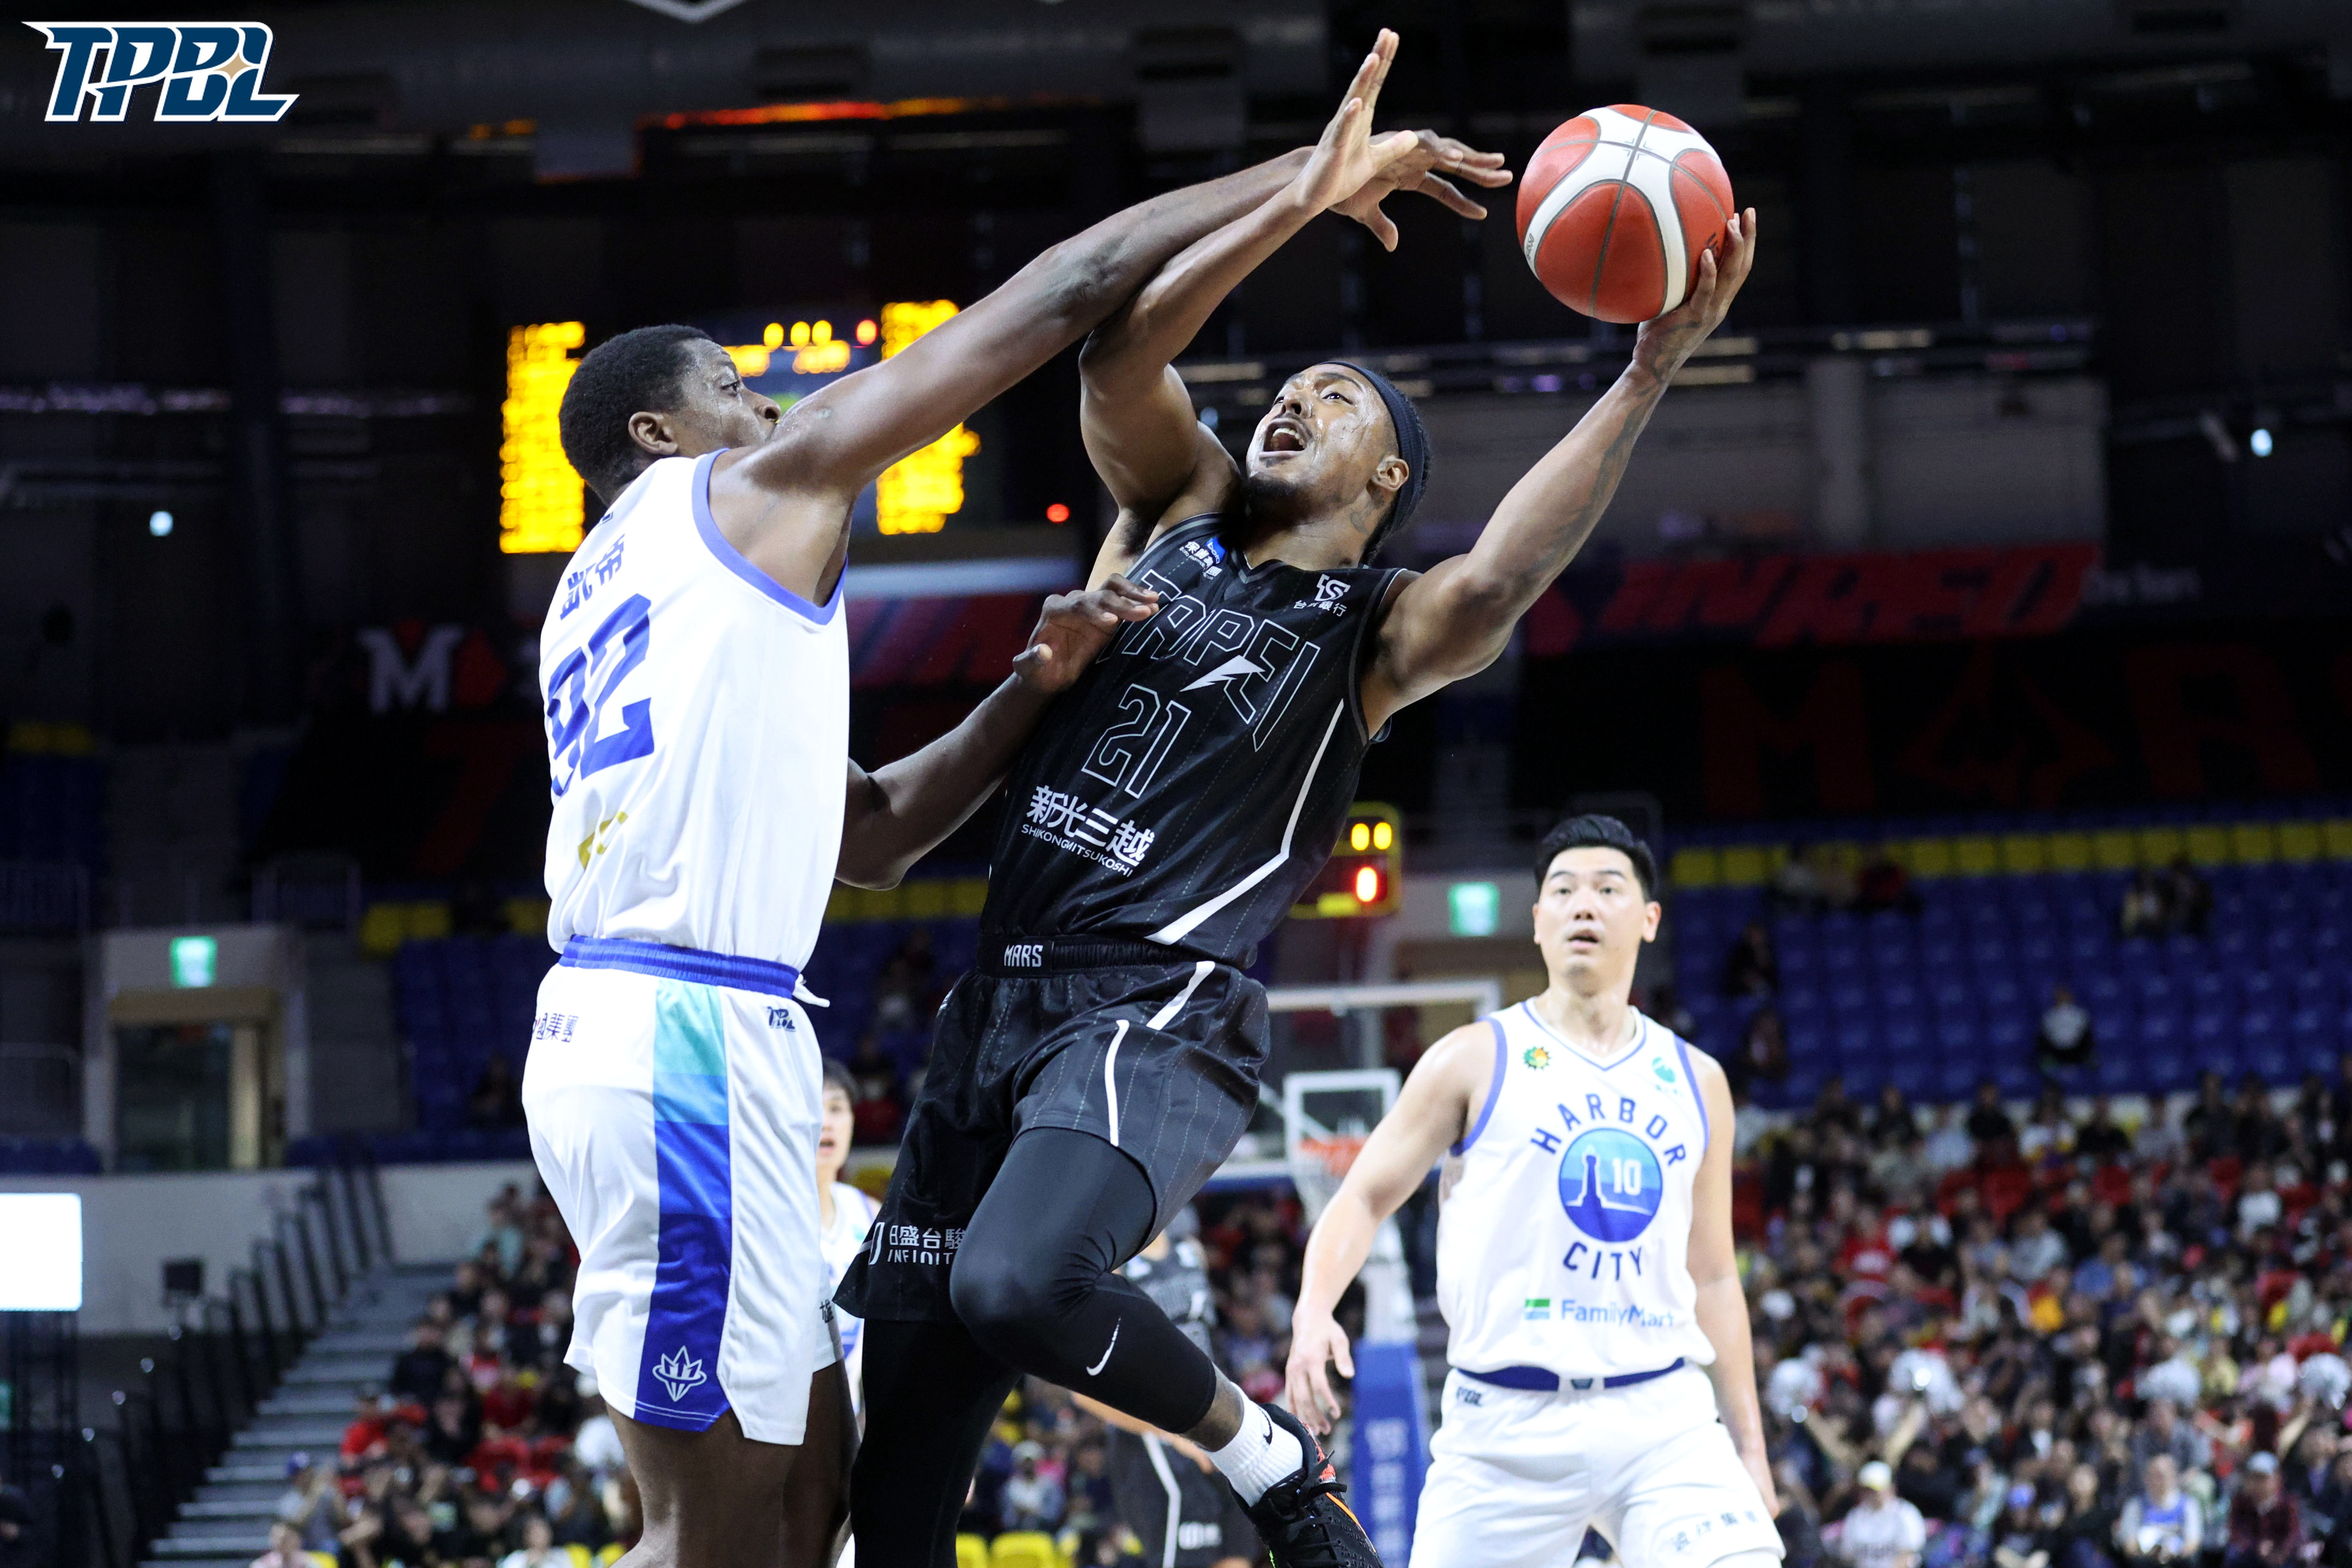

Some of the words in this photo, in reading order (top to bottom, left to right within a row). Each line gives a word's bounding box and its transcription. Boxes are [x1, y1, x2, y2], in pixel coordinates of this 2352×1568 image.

[547, 593, 654, 797] 92
[1081, 683, 1192, 799] 21
[1026, 785, 1155, 867] 新光三越
[1004, 944, 1044, 967] MARS
[1529, 1093, 1686, 1168] HARBOR
[1612, 1158, 1641, 1196] 10
[887, 1249, 953, 1265] INFINIT
[1563, 1241, 1642, 1281] CITY
[1561, 1299, 1674, 1328] FamilyMart
